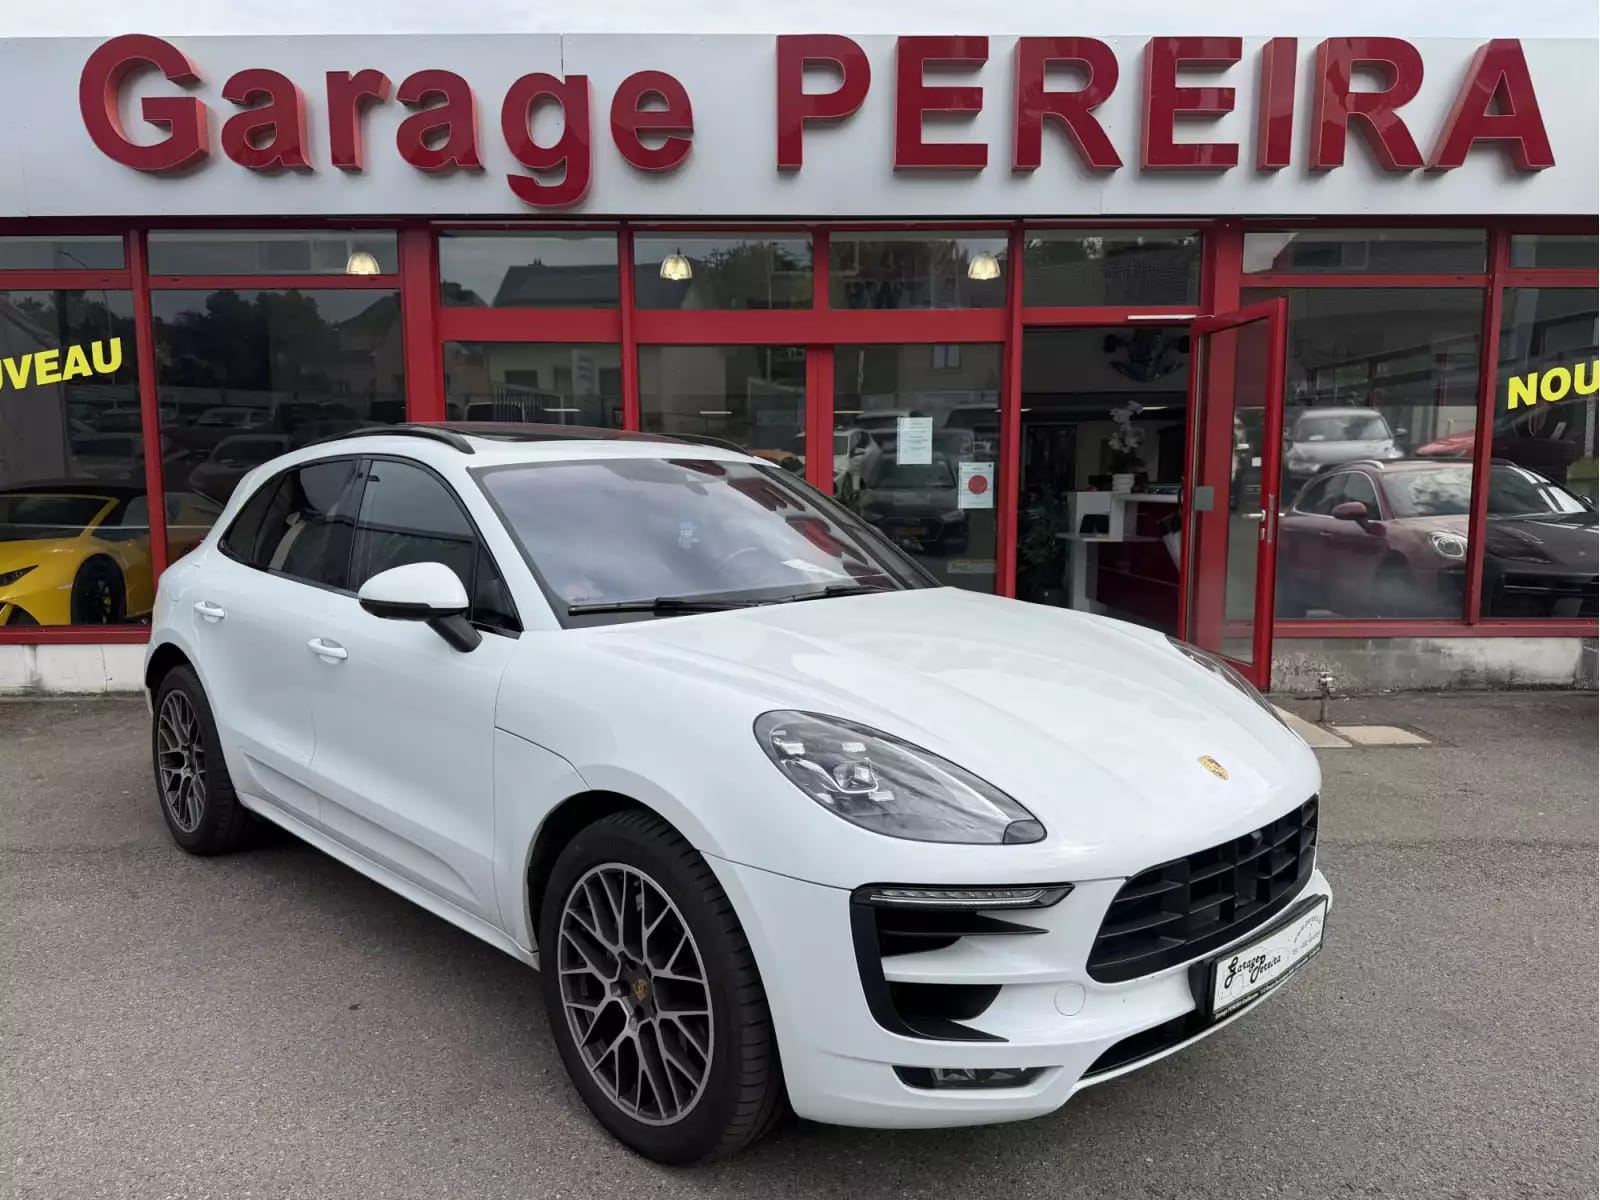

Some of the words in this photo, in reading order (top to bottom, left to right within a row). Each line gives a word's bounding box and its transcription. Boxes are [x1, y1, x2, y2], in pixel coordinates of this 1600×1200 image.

[79, 34, 693, 207] Garage
[777, 34, 1555, 171] PEREIRA
[0, 337, 122, 390] VEAU
[1508, 360, 1600, 410] NOU
[1224, 956, 1261, 989] Garage
